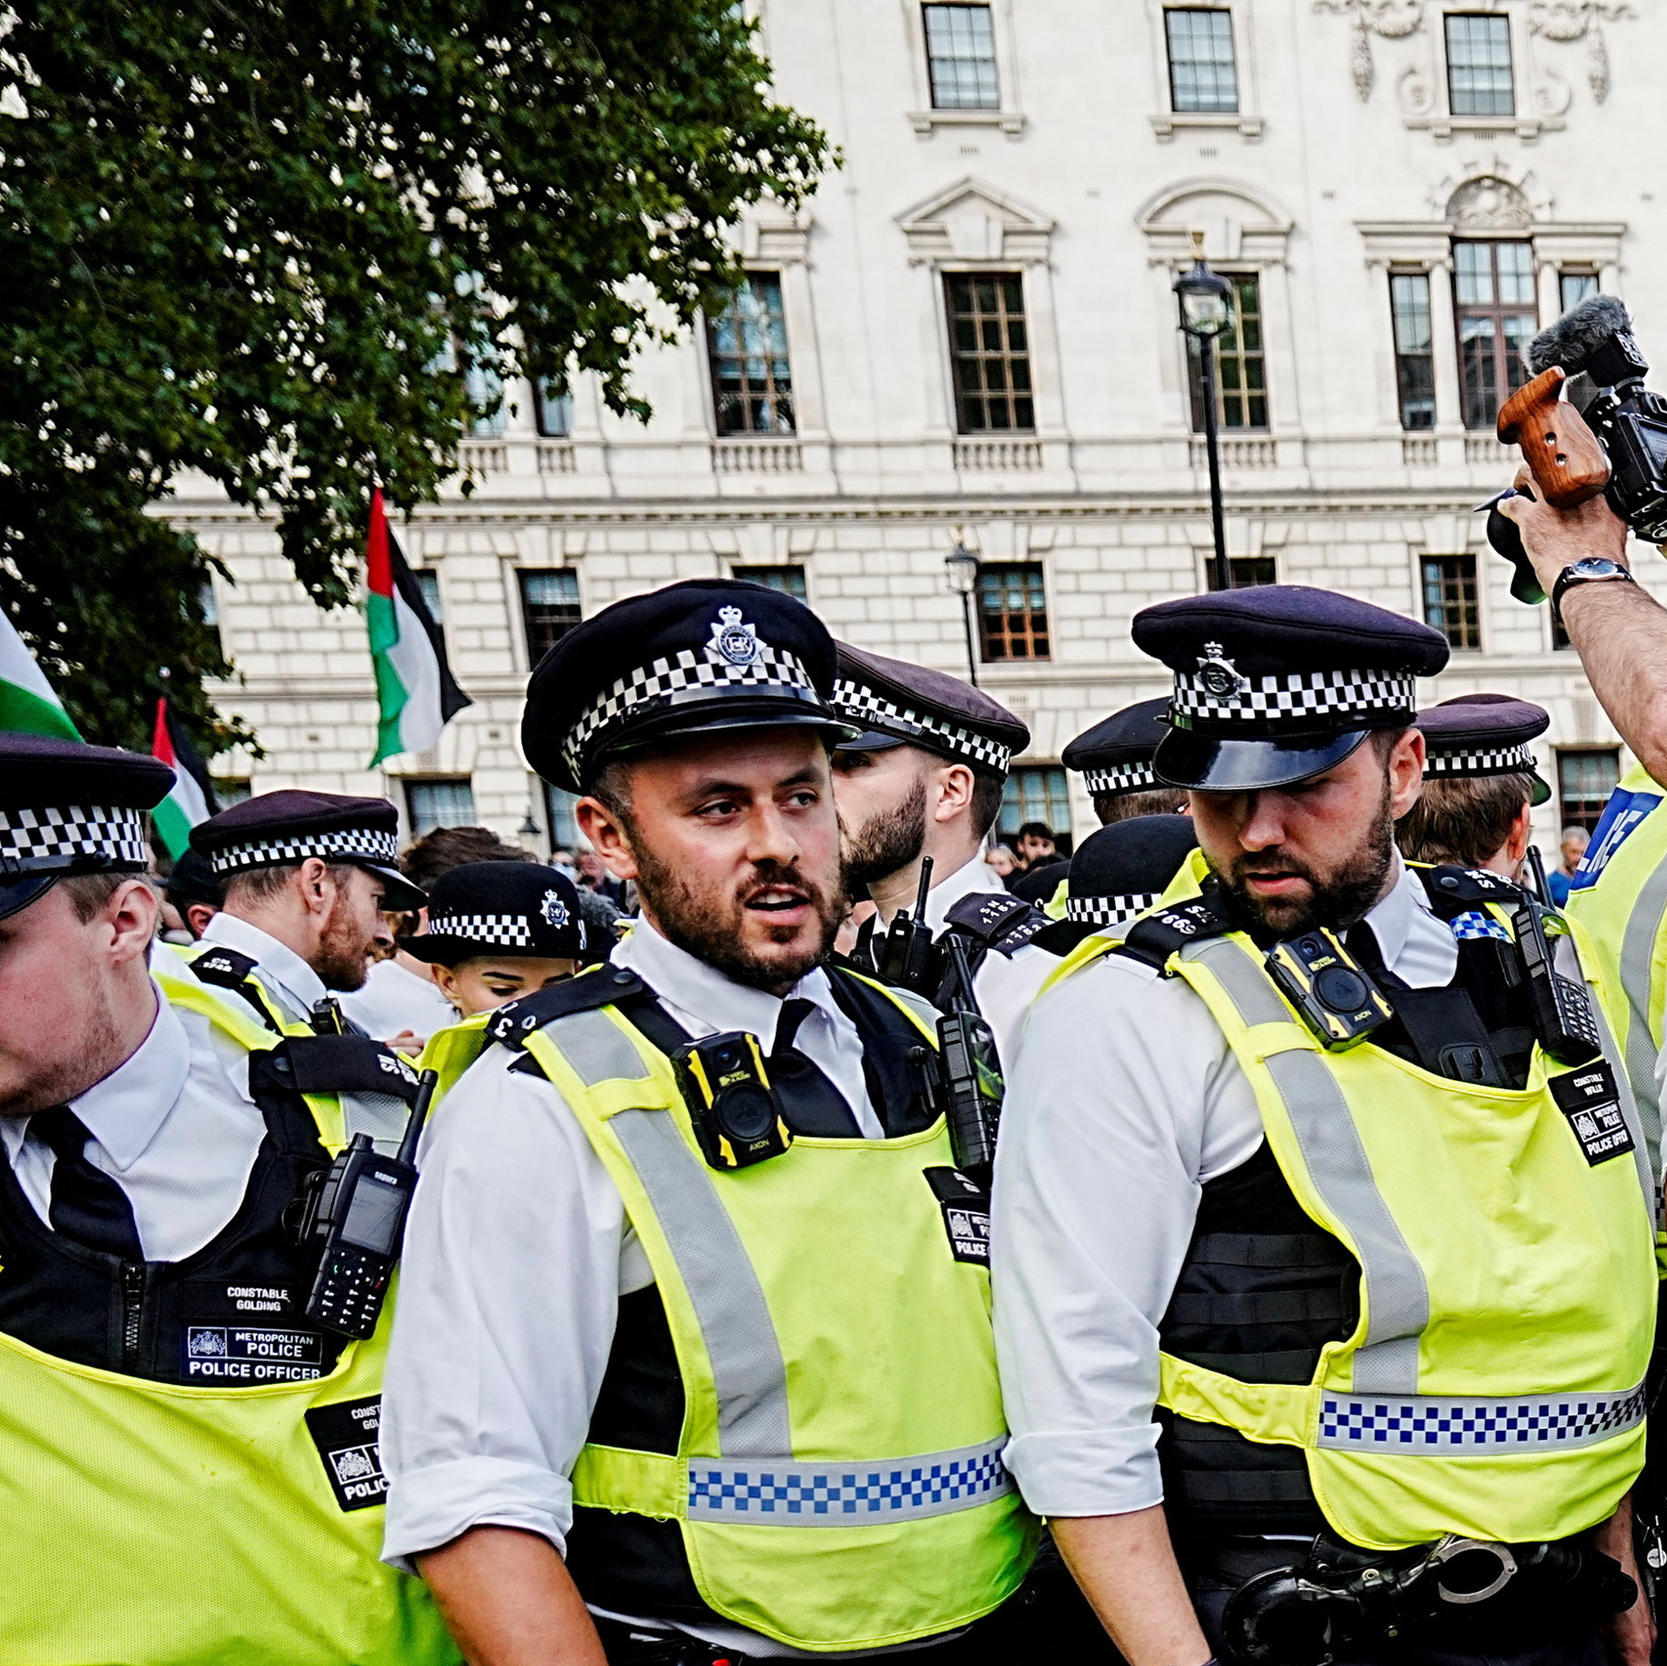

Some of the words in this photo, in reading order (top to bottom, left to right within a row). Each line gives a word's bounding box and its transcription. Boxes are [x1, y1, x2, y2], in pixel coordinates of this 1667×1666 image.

[749, 1139, 770, 1152] AXON
[1586, 1136, 1613, 1156] POLICE
[955, 1241, 987, 1257] POLICE
[227, 1287, 288, 1300] CONSTABLE
[236, 1300, 282, 1312] GOLDING
[235, 1332, 314, 1345] METROPOLITAN
[247, 1343, 303, 1357] POLICE
[189, 1361, 251, 1377] POLICE
[254, 1365, 321, 1380] OFFICER
